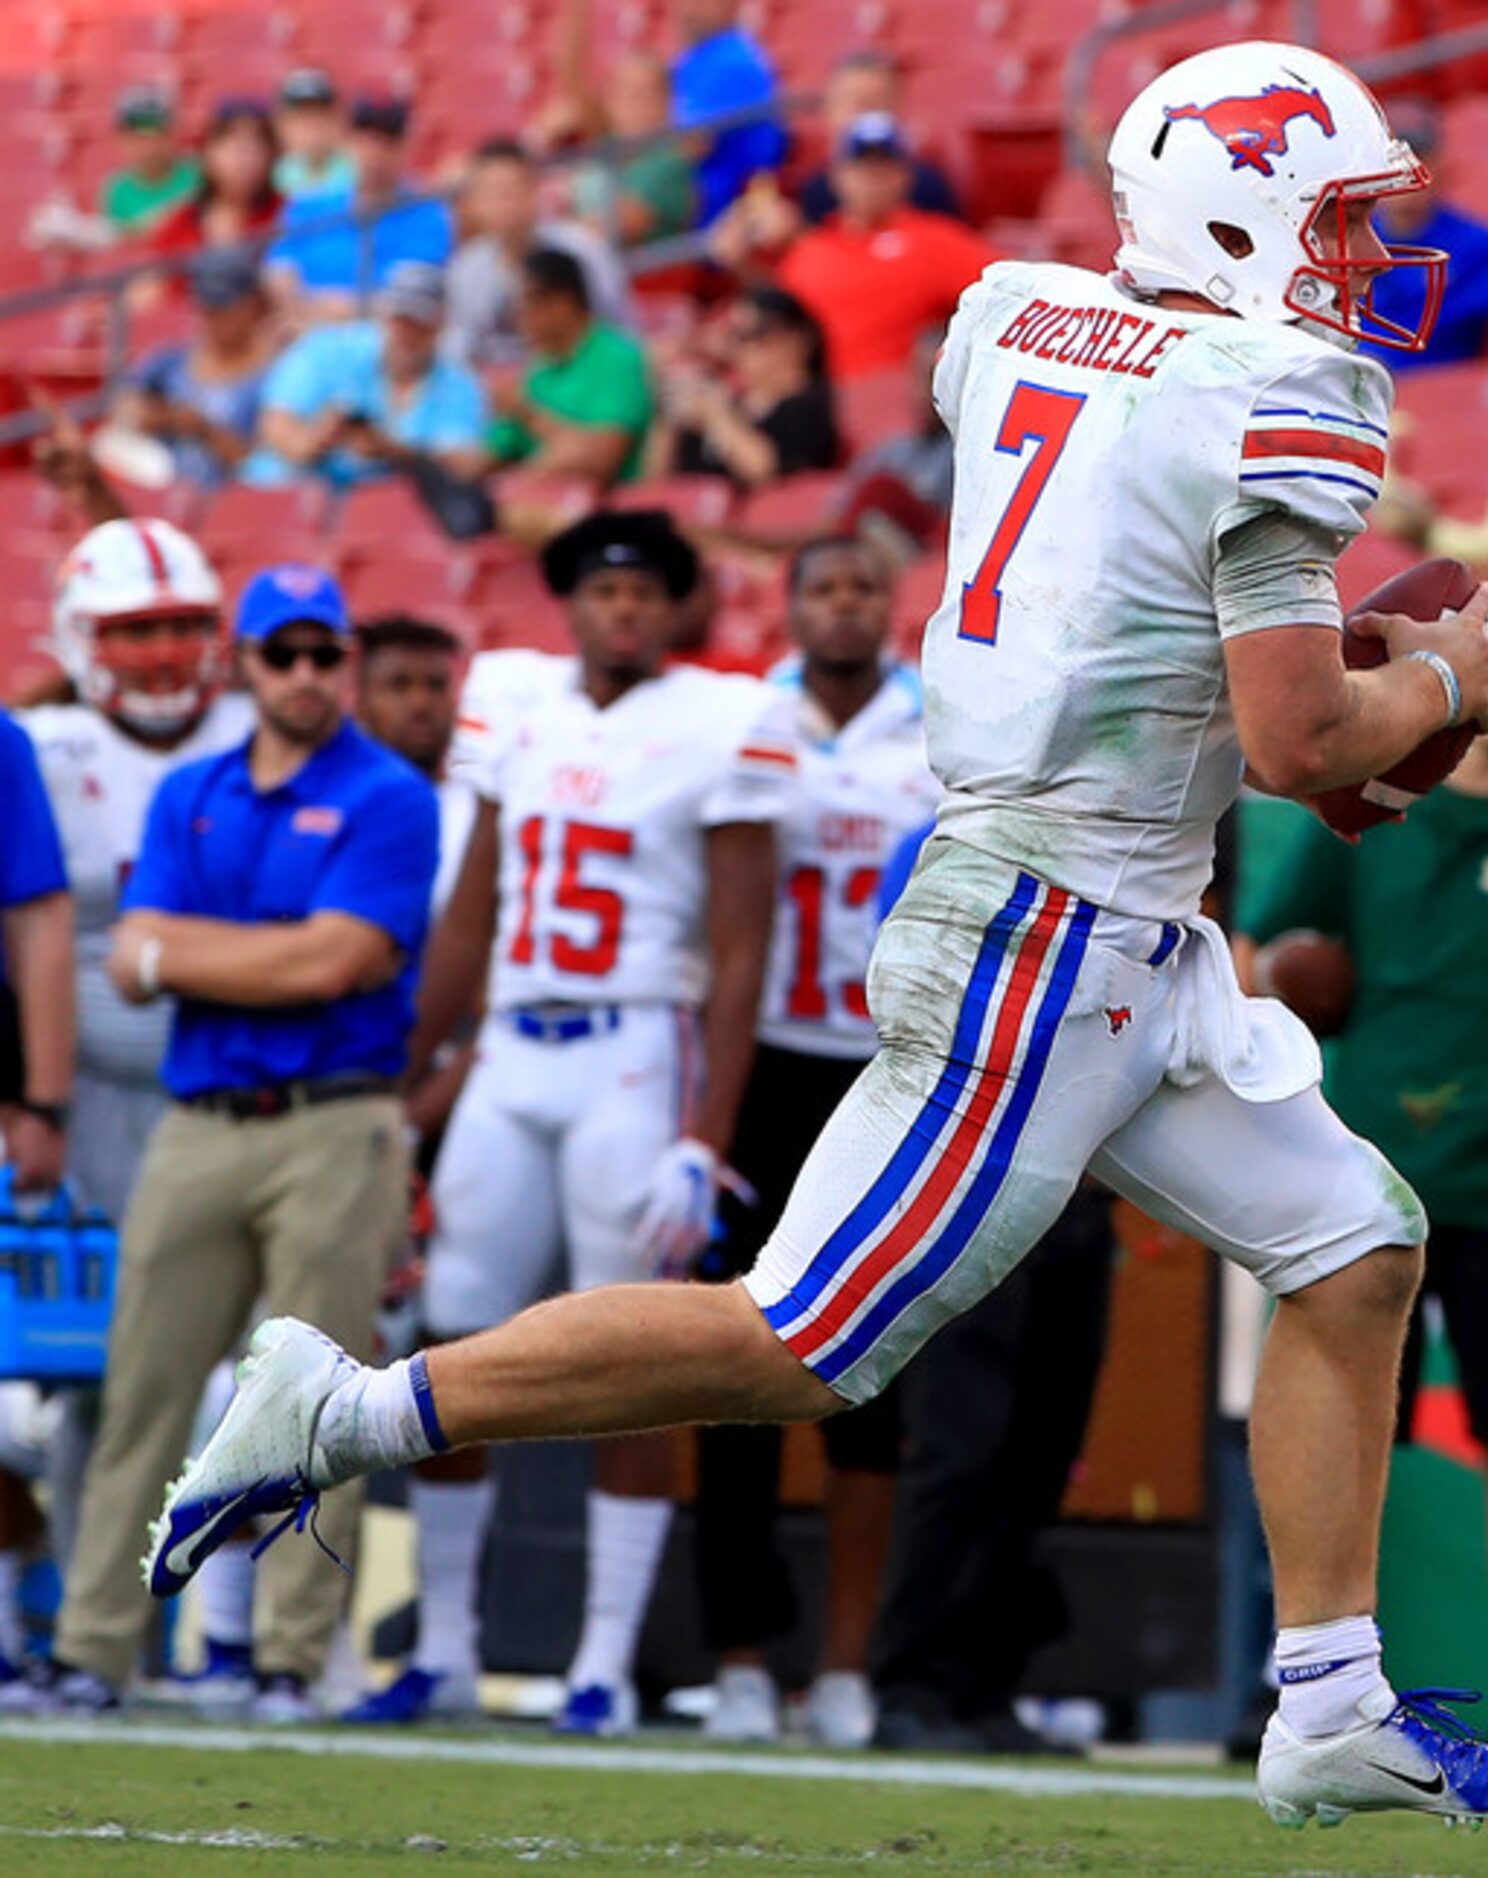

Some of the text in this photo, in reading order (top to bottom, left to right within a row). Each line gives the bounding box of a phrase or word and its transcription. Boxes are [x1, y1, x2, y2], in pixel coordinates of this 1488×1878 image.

[996, 298, 1187, 379] BUECHELE
[957, 379, 1088, 646] 7
[510, 814, 634, 978] 15
